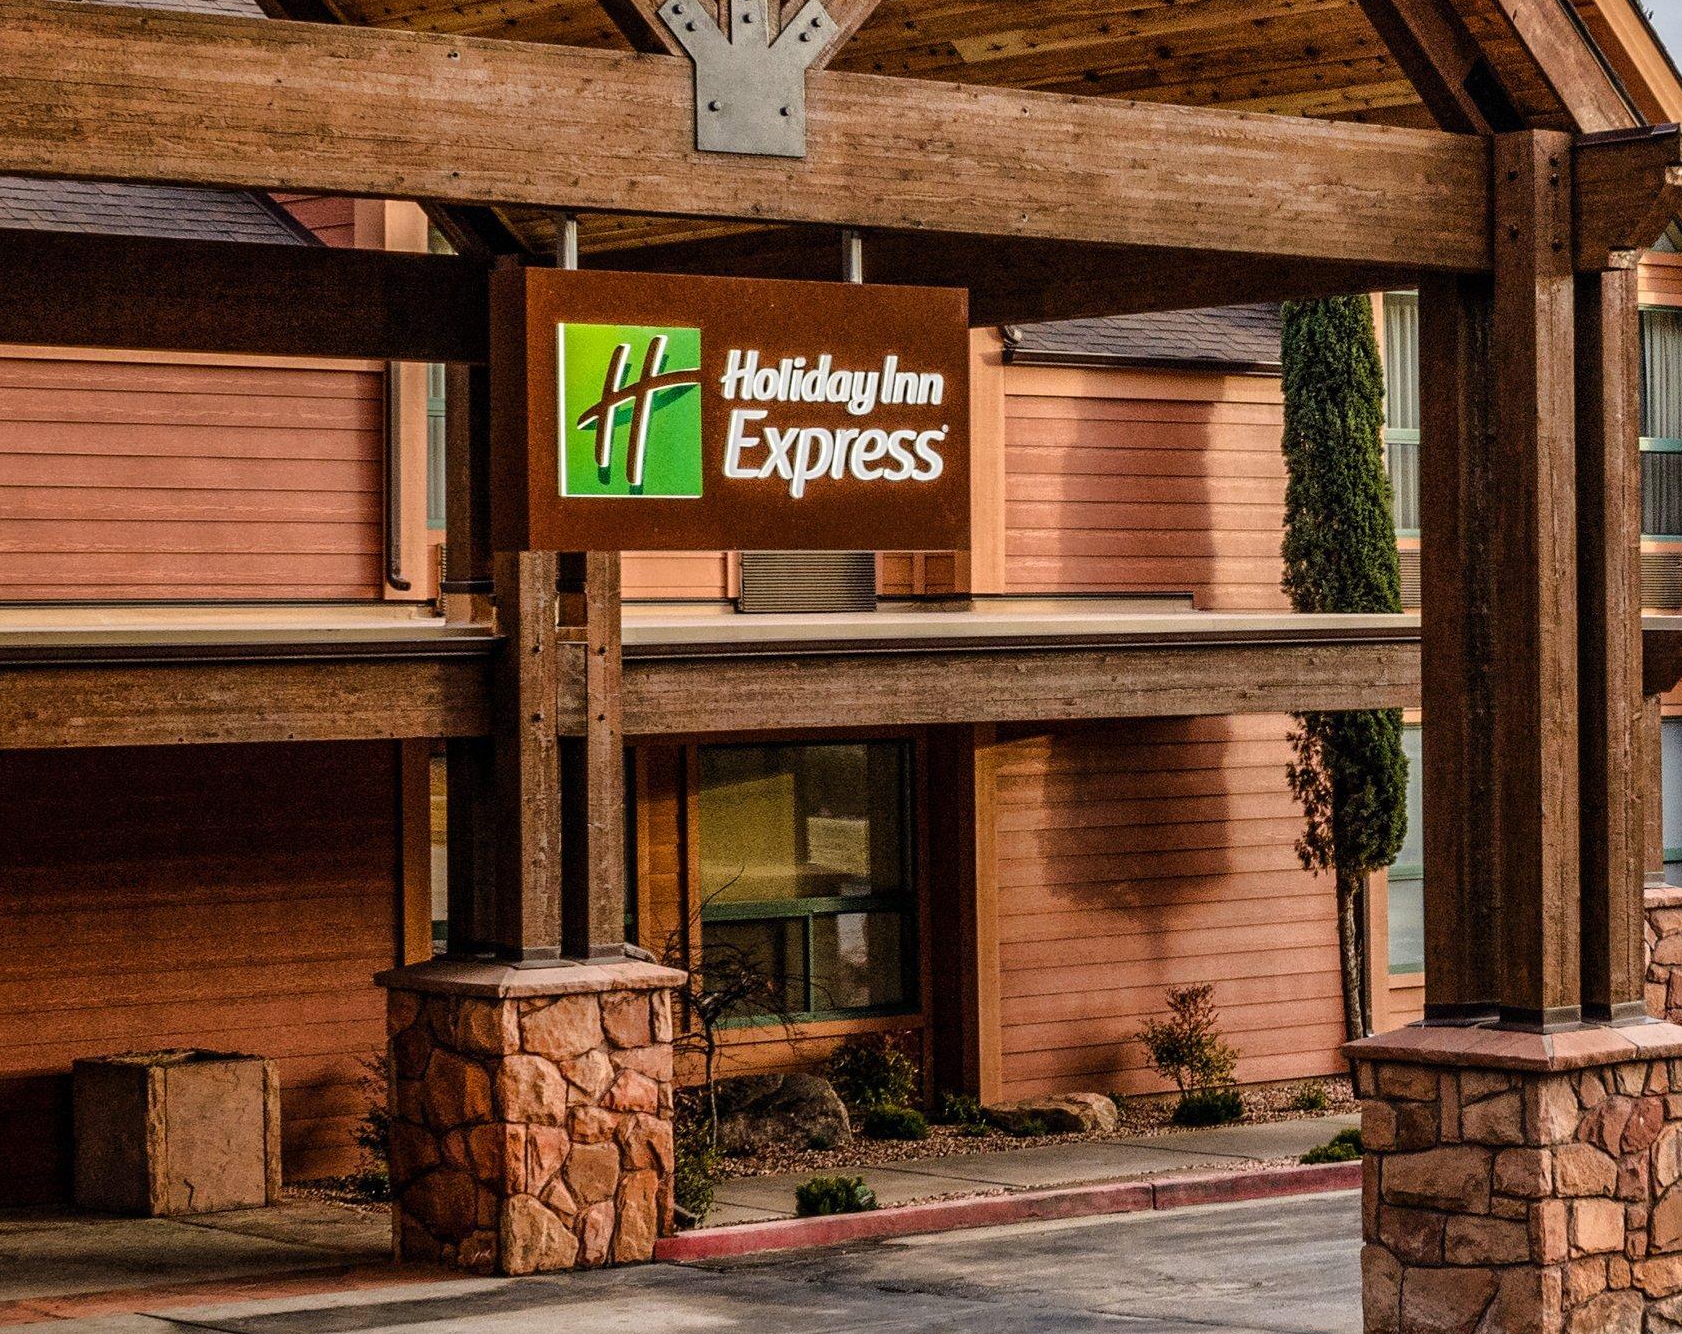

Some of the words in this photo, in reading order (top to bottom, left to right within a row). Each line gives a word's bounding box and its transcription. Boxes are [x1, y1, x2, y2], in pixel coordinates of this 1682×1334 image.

[720, 349, 880, 416] Holiday
[880, 355, 945, 406] Inn
[723, 409, 948, 499] Express
